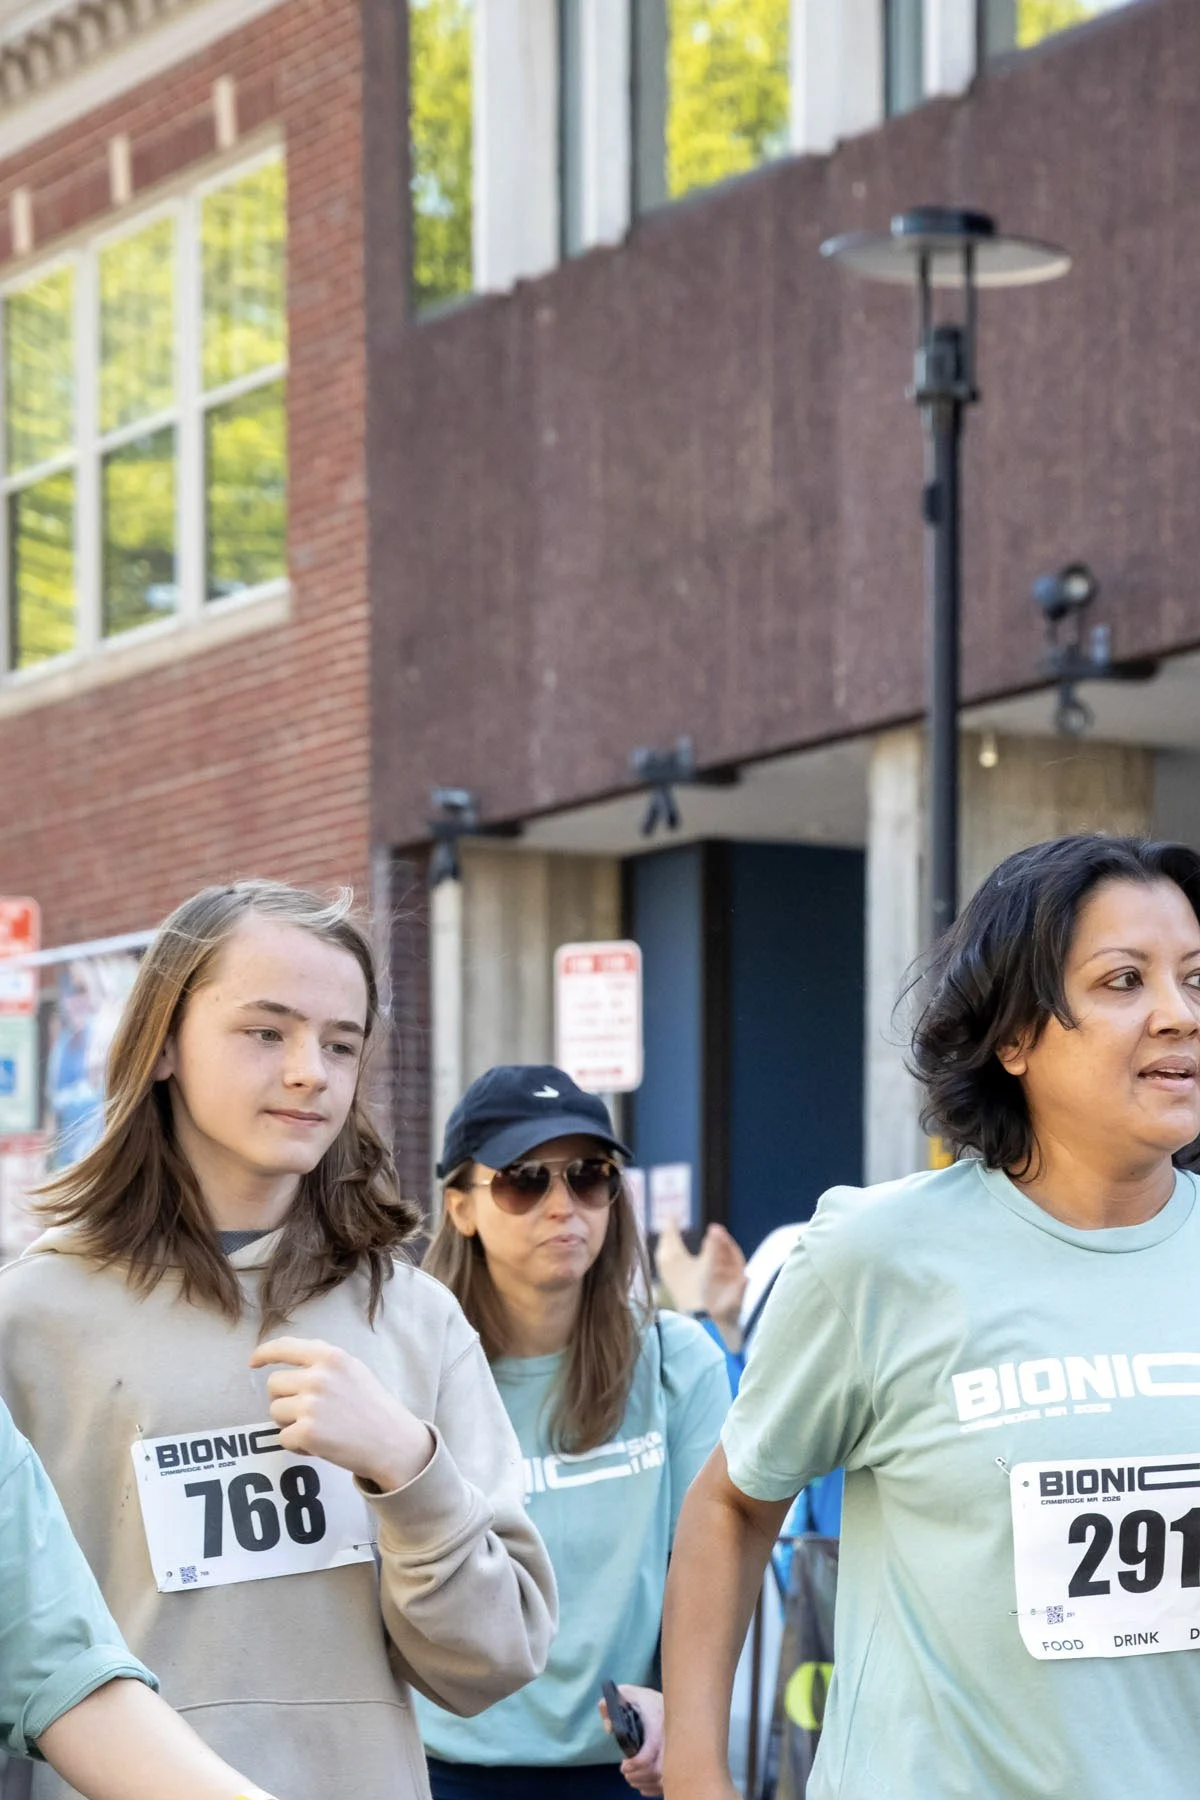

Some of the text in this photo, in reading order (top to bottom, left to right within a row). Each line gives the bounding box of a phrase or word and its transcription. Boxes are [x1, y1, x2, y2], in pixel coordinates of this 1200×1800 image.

[156, 1428, 286, 1469] BIONIC
[160, 1465, 202, 1477] CAMBRIDGE
[1039, 1462, 1200, 1497] BIONIC
[184, 1464, 326, 1559] 768
[1041, 1497, 1085, 1506] CAMBRIDGE
[1102, 1495, 1121, 1503] 2026
[1042, 1638, 1084, 1652] FOOD
[1113, 1631, 1160, 1648] DRINK
